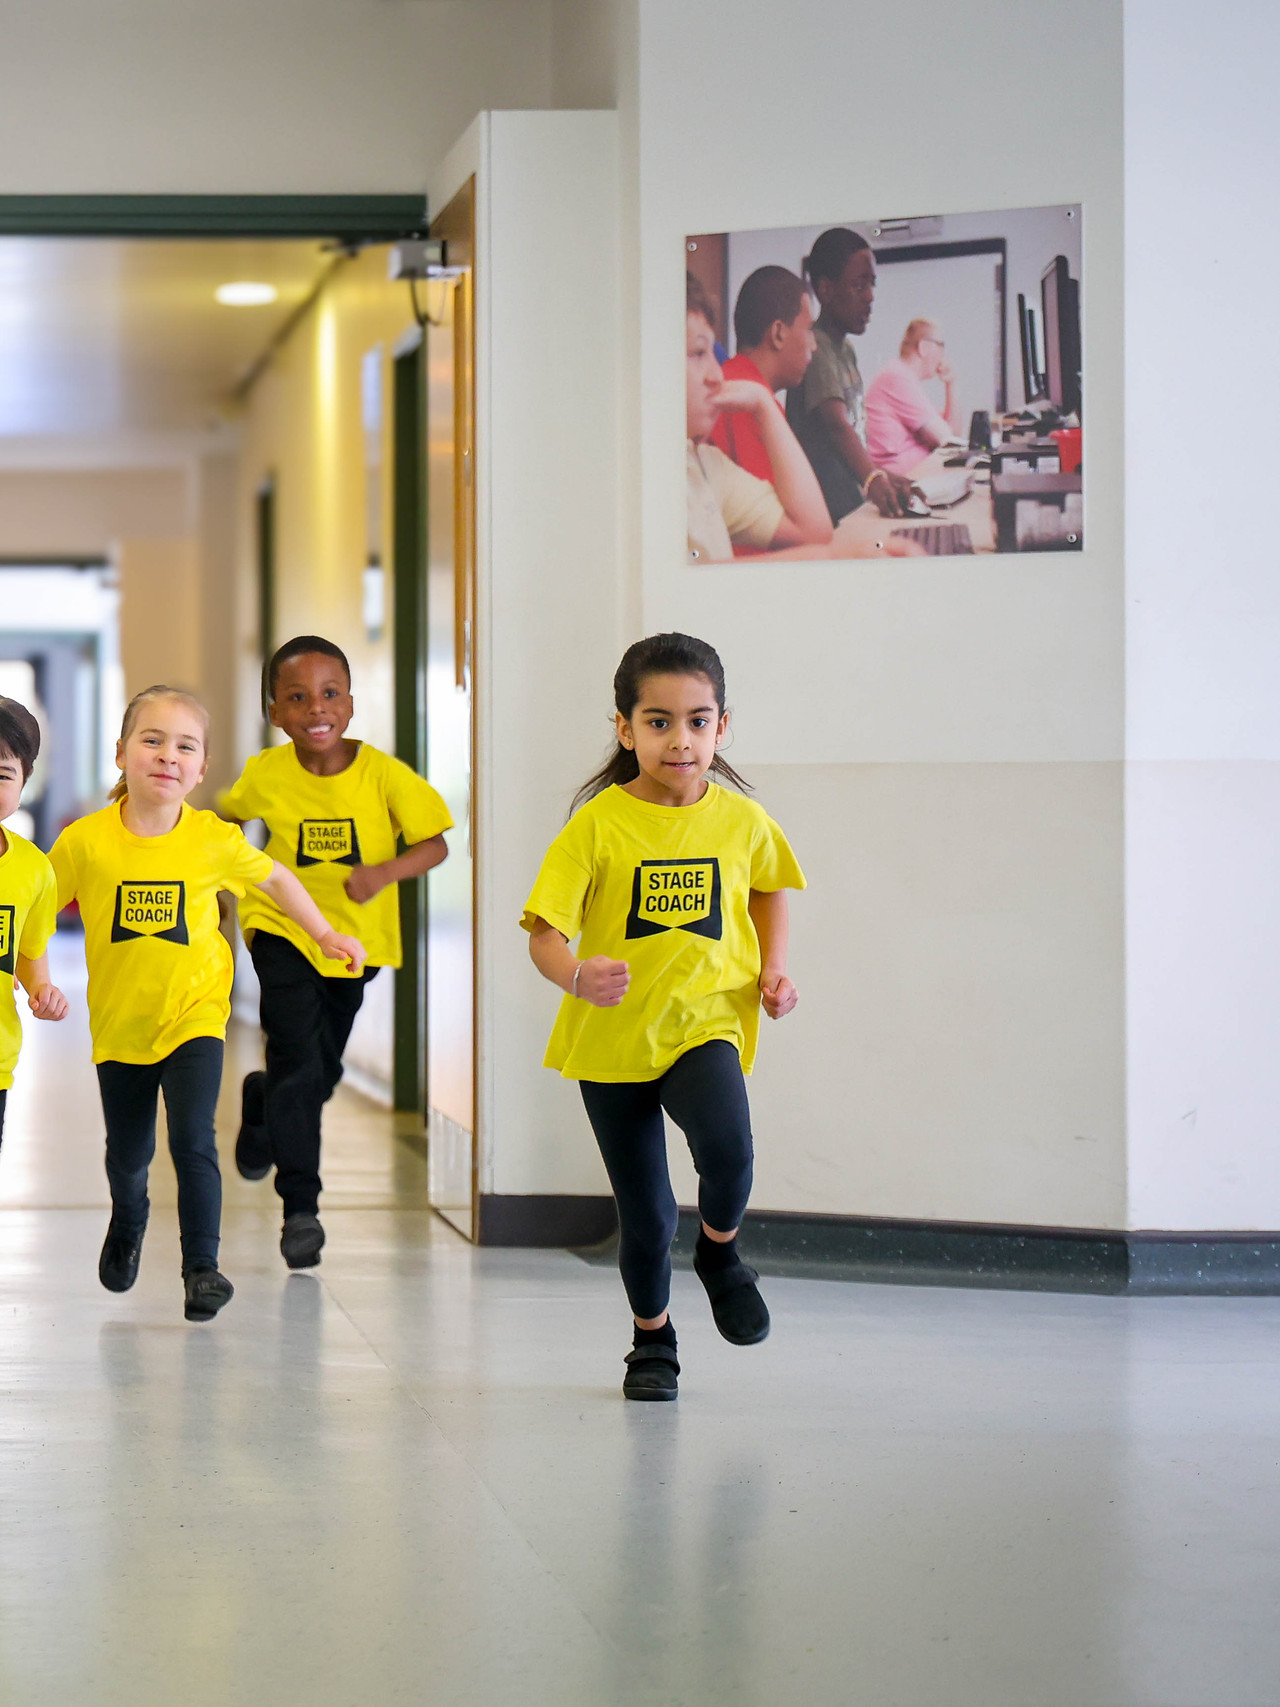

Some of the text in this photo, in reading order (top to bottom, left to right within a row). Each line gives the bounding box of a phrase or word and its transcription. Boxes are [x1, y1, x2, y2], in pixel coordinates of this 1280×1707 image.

[308, 827, 346, 838] STAGE
[307, 840, 348, 851] COACH
[648, 871, 705, 890] STAGE
[127, 891, 173, 905] STAGE
[645, 894, 706, 913] COACH
[125, 908, 173, 923] COACH
